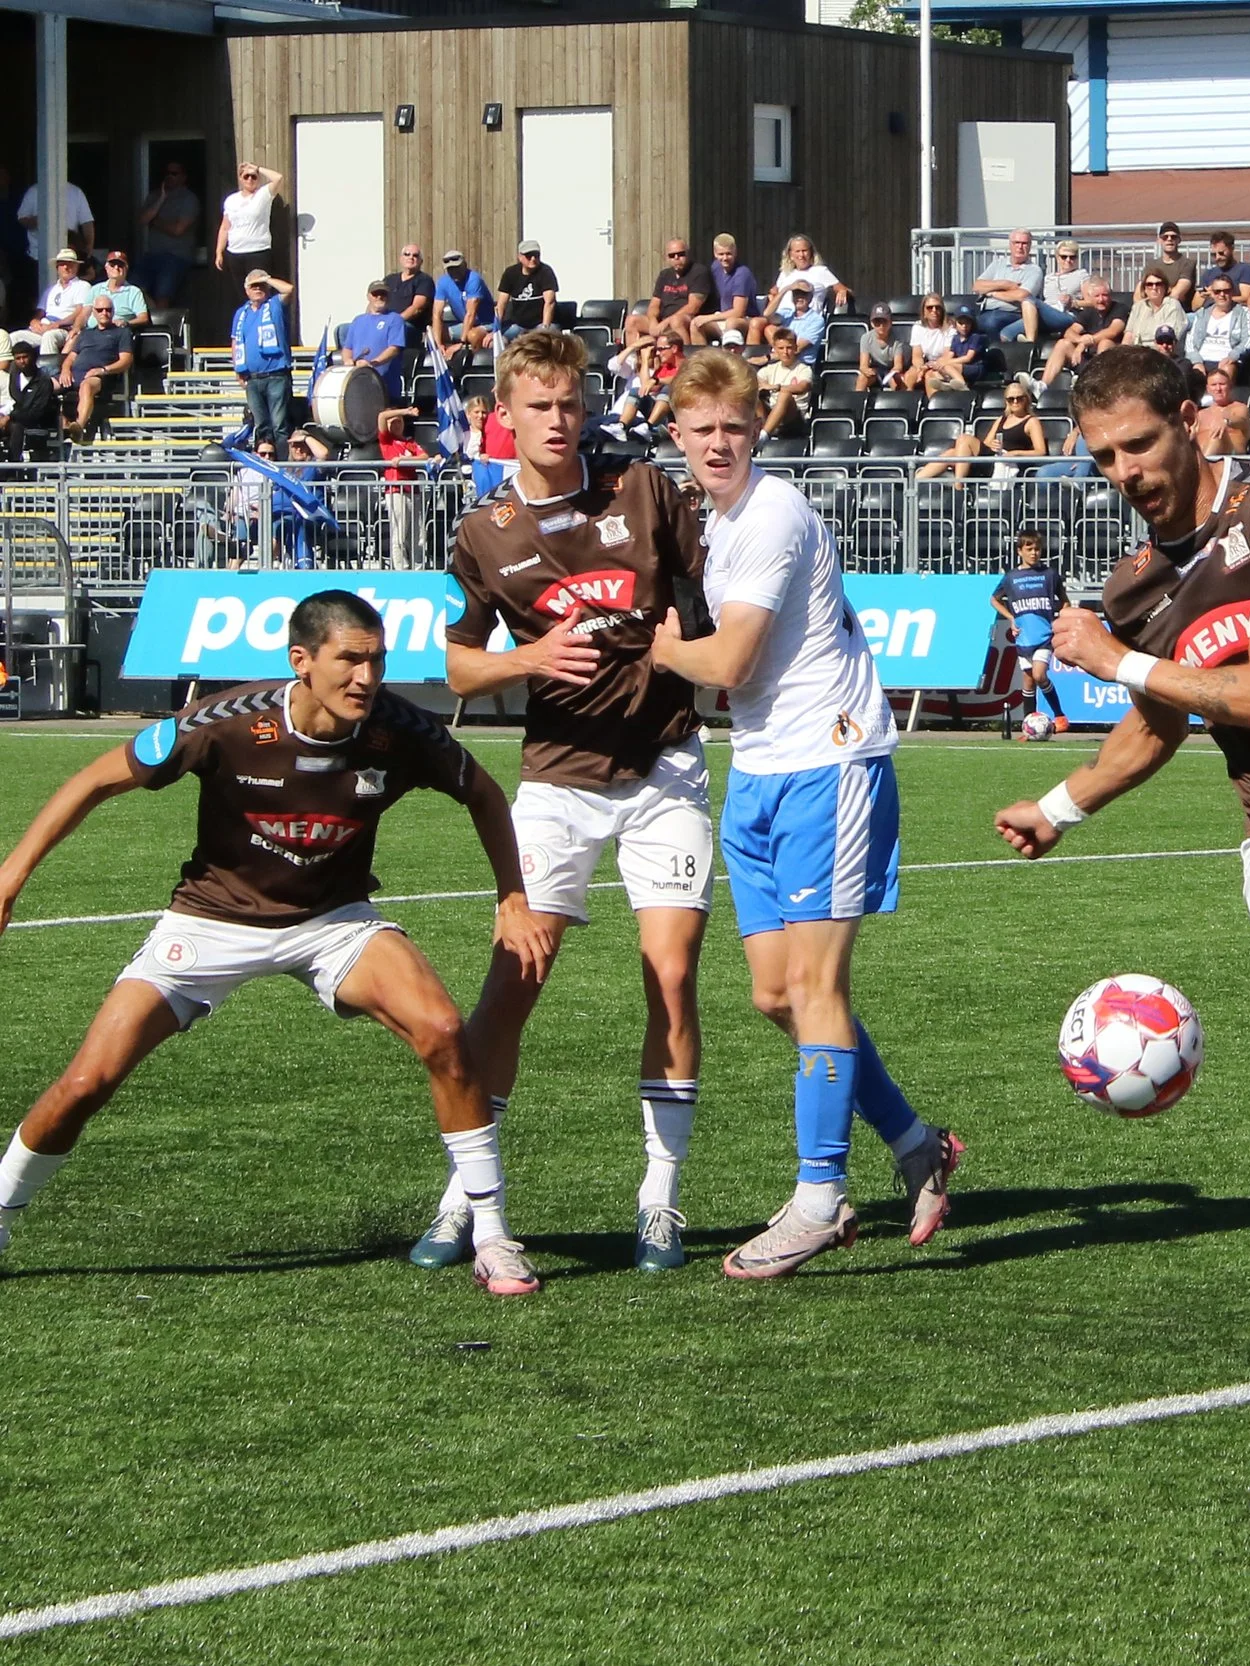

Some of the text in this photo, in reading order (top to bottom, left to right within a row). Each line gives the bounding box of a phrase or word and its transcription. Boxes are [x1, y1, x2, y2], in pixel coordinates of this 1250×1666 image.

[546, 579, 624, 615] MENY
[248, 776, 284, 788] hummel
[259, 820, 354, 842] MENY
[522, 854, 535, 875] B
[670, 855, 696, 878] 18
[652, 880, 692, 891] hummel
[167, 943, 182, 962] B
